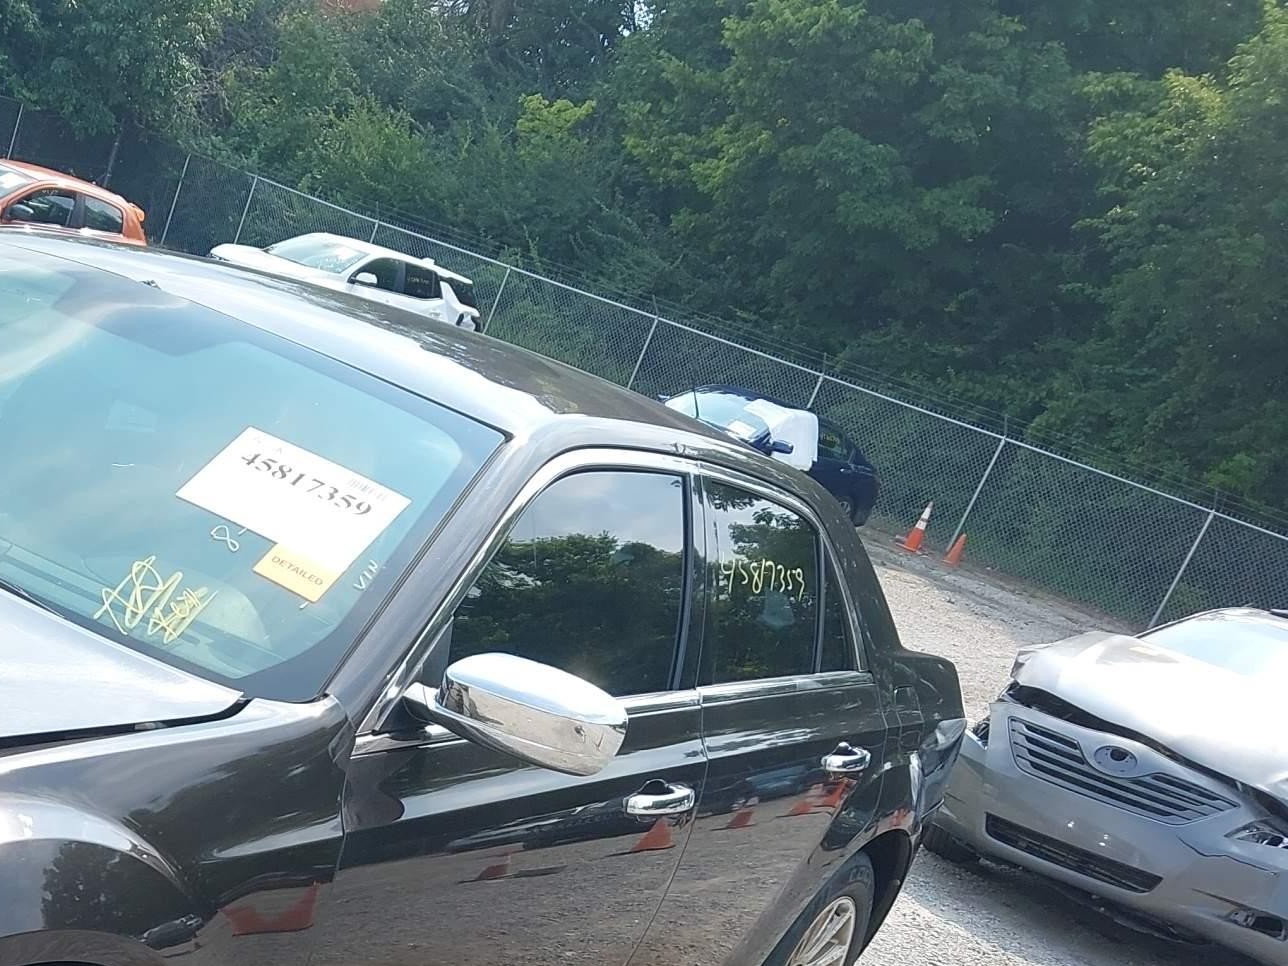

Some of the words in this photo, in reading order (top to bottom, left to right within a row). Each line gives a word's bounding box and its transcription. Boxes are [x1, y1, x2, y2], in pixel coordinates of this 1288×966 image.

[241, 454, 372, 516] 45817359
[271, 555, 324, 586] DETAILED
[353, 559, 380, 592] VIN
